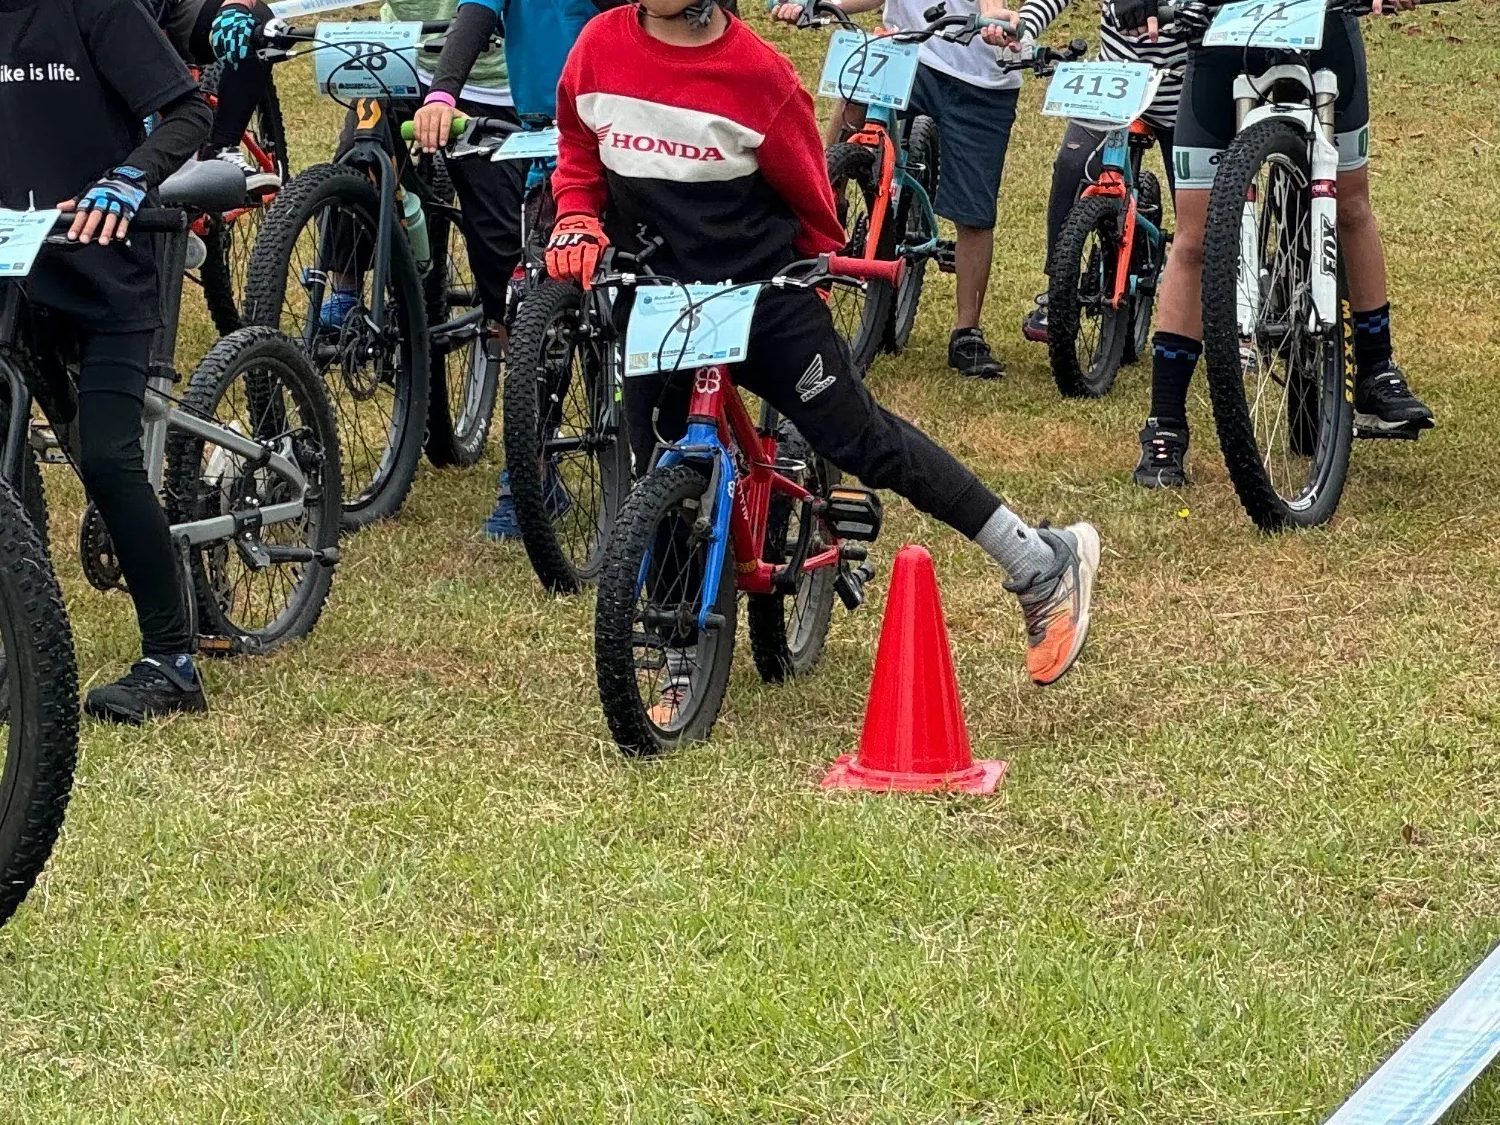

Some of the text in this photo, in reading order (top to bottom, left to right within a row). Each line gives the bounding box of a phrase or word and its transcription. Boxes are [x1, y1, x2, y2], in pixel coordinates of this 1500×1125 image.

[1241, 2, 1289, 21] 41
[343, 42, 388, 71] 28
[847, 50, 889, 77] 27
[29, 63, 44, 81] is
[47, 63, 80, 82] life.
[1063, 75, 1129, 99] 413
[611, 132, 726, 161] HONDA
[547, 234, 584, 249] FOX
[1320, 213, 1338, 279] FOX
[1341, 299, 1357, 403] MAXXIS
[802, 376, 836, 402] HONDA
